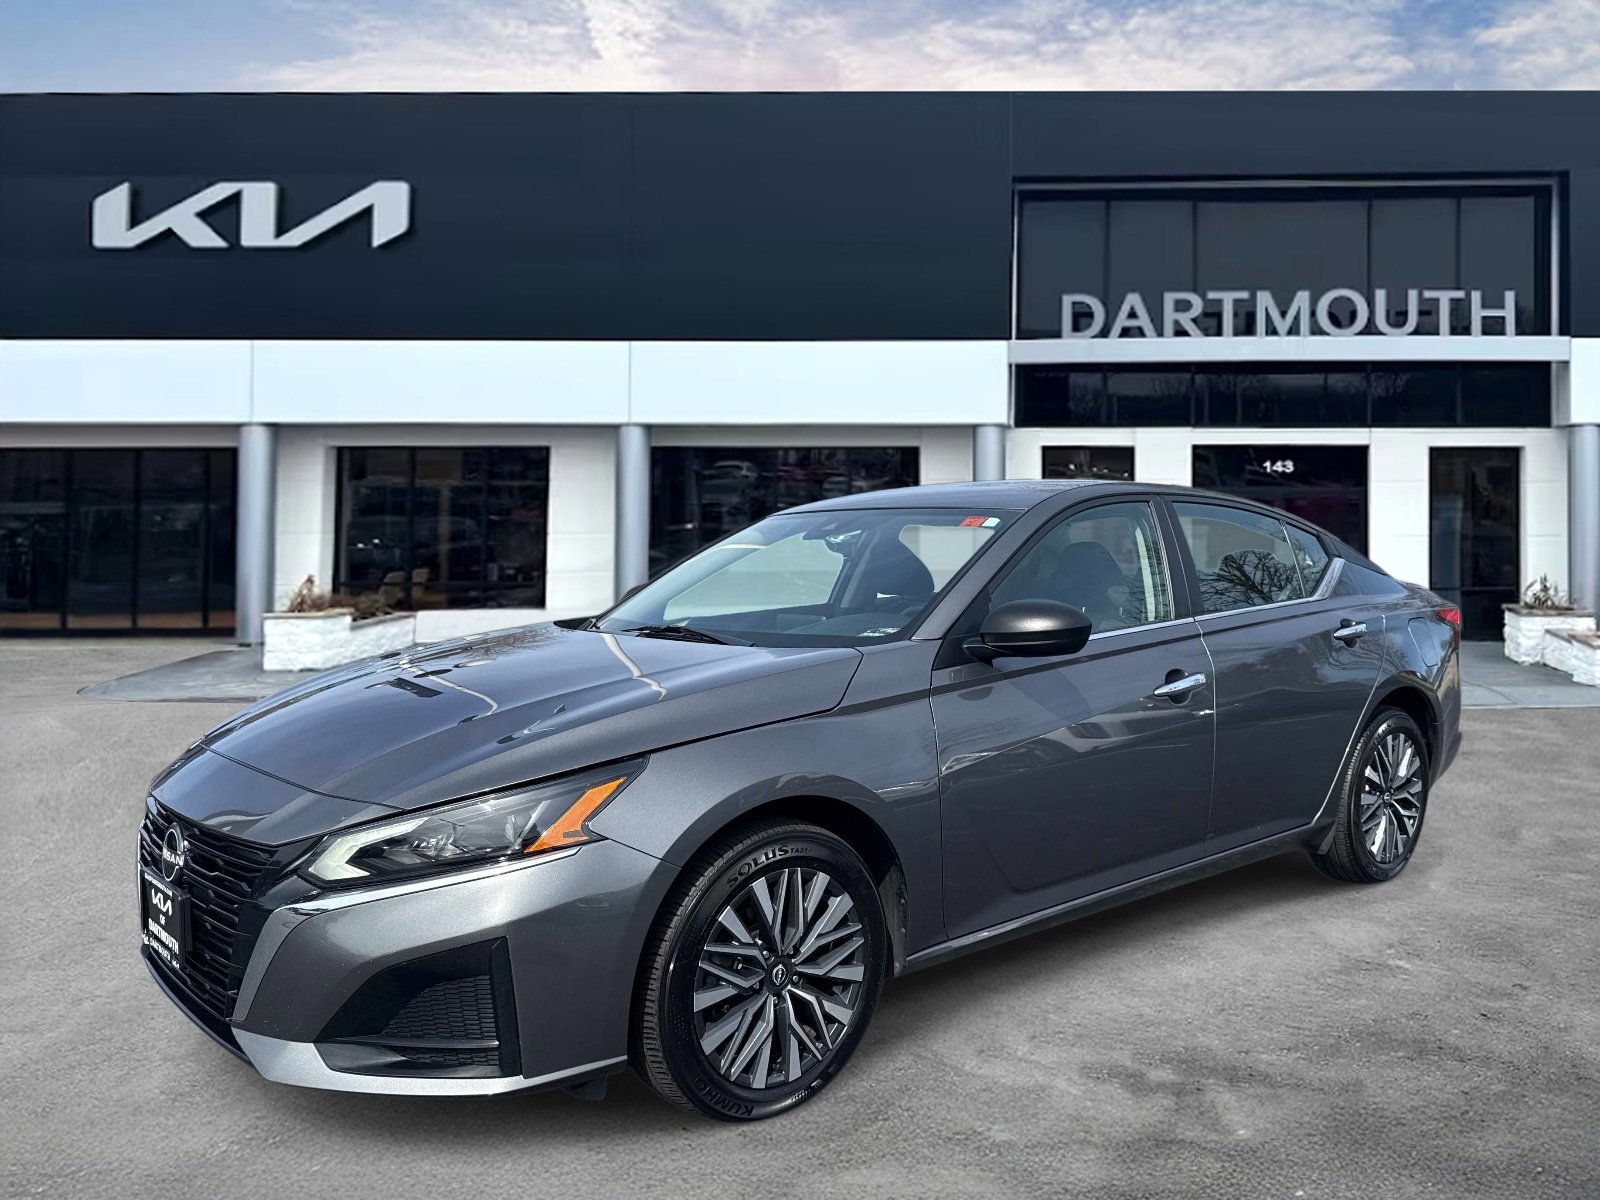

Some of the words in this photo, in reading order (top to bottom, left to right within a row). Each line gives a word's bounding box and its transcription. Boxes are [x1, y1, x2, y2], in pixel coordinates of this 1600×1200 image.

[92, 181, 410, 248] KIA
[1060, 288, 1517, 338] DARTMOUTH
[1263, 459, 1295, 473] 143
[726, 845, 790, 888] SOLUS
[148, 917, 179, 955] DARTMOUTH
[159, 913, 166, 926] OF
